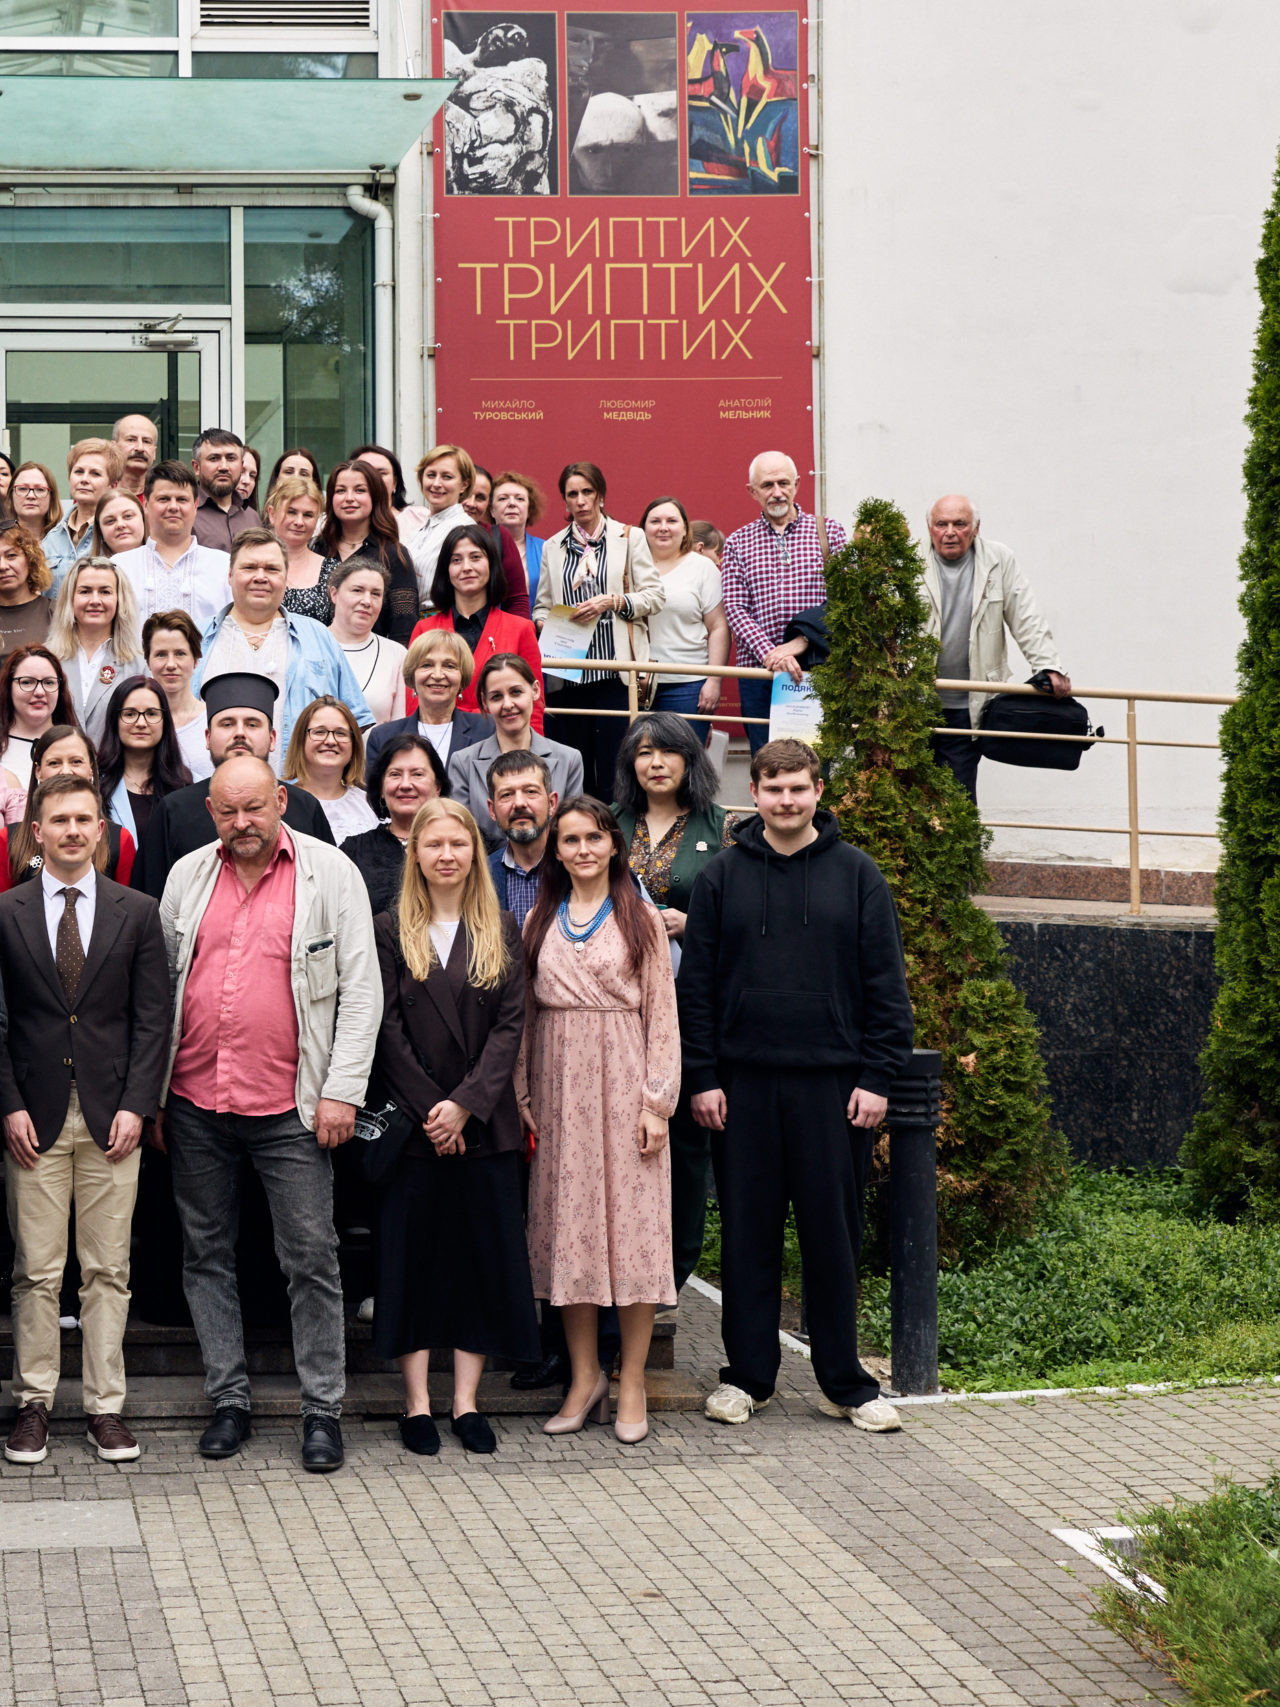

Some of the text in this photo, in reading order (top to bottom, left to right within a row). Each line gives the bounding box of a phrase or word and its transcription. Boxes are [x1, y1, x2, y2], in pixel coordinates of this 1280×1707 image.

[494, 216, 752, 258] ТРИПТИХ
[458, 262, 788, 315] ТРИПТИХ
[496, 319, 753, 361] ТРИПТИХ
[482, 399, 535, 409] МИХАЙЛО
[599, 400, 655, 409] ЛЮБОМИР
[719, 397, 772, 408] АНАТОЛІЙ
[473, 410, 544, 420] ТУРОВСЬКИЙ
[604, 411, 652, 421] МЕДВІДЬ
[720, 410, 771, 419] МЕЛЬНИК
